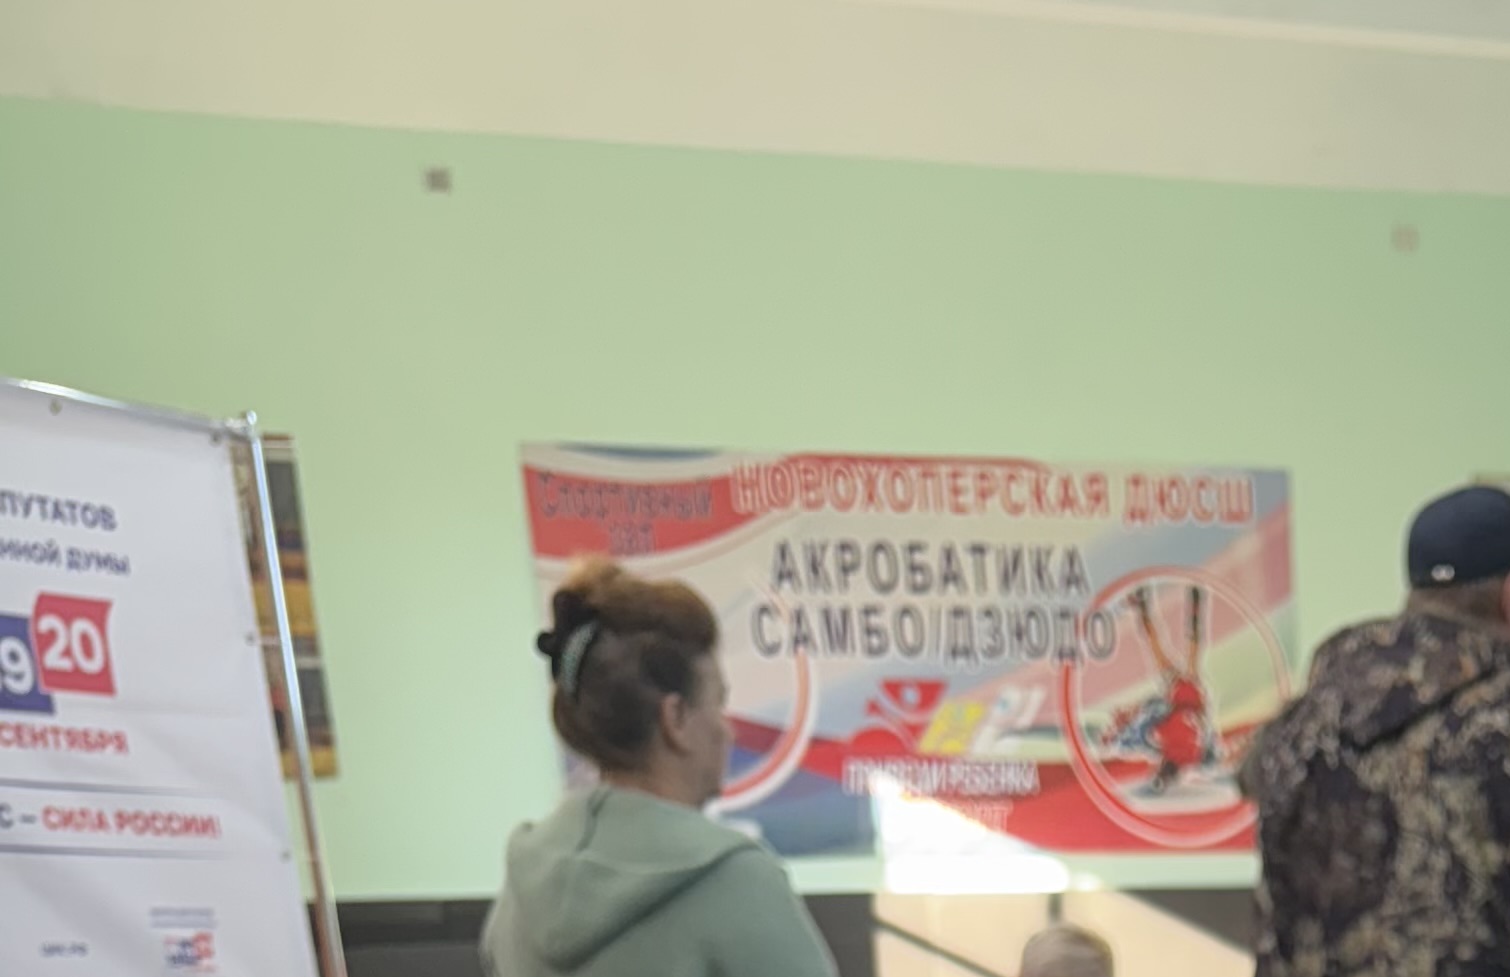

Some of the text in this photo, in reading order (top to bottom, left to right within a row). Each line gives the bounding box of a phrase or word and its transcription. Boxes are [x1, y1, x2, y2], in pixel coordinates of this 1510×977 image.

[1121, 472, 1254, 526] ДЮСШ
[66, 546, 131, 576] ДУМЫ
[768, 538, 1090, 598] АКРОБАТИКА
[37, 614, 105, 674] 20
[0, 721, 129, 754] СЕНТЯБРЯ
[42, 805, 110, 834] СИЛА
